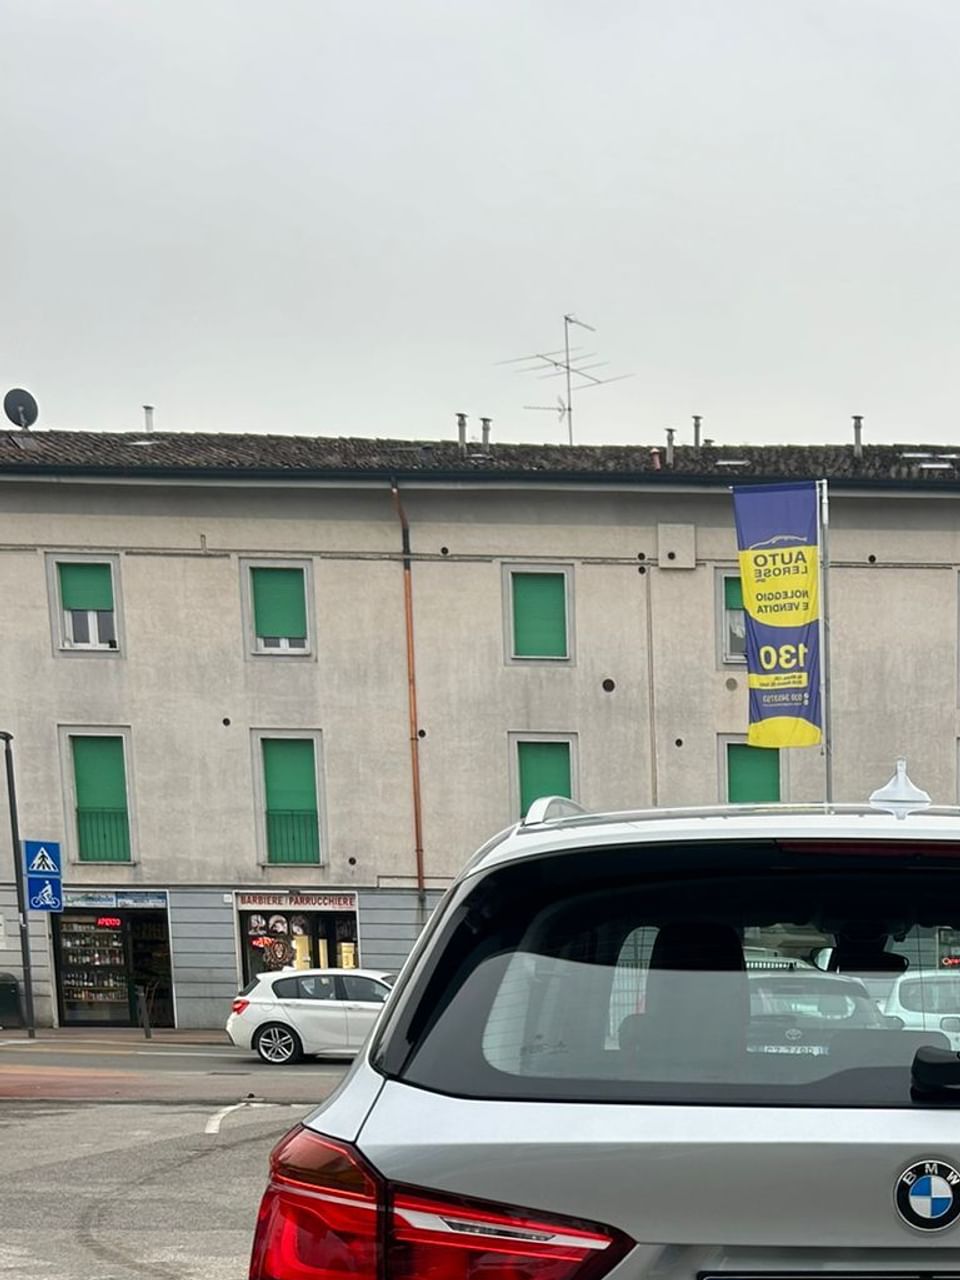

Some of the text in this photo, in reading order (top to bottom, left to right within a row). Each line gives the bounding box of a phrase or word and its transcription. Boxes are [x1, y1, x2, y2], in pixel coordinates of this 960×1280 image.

[240, 895, 354, 907] BARBIERE PARRUCCHIERE
[902, 1163, 960, 1186] BMW
